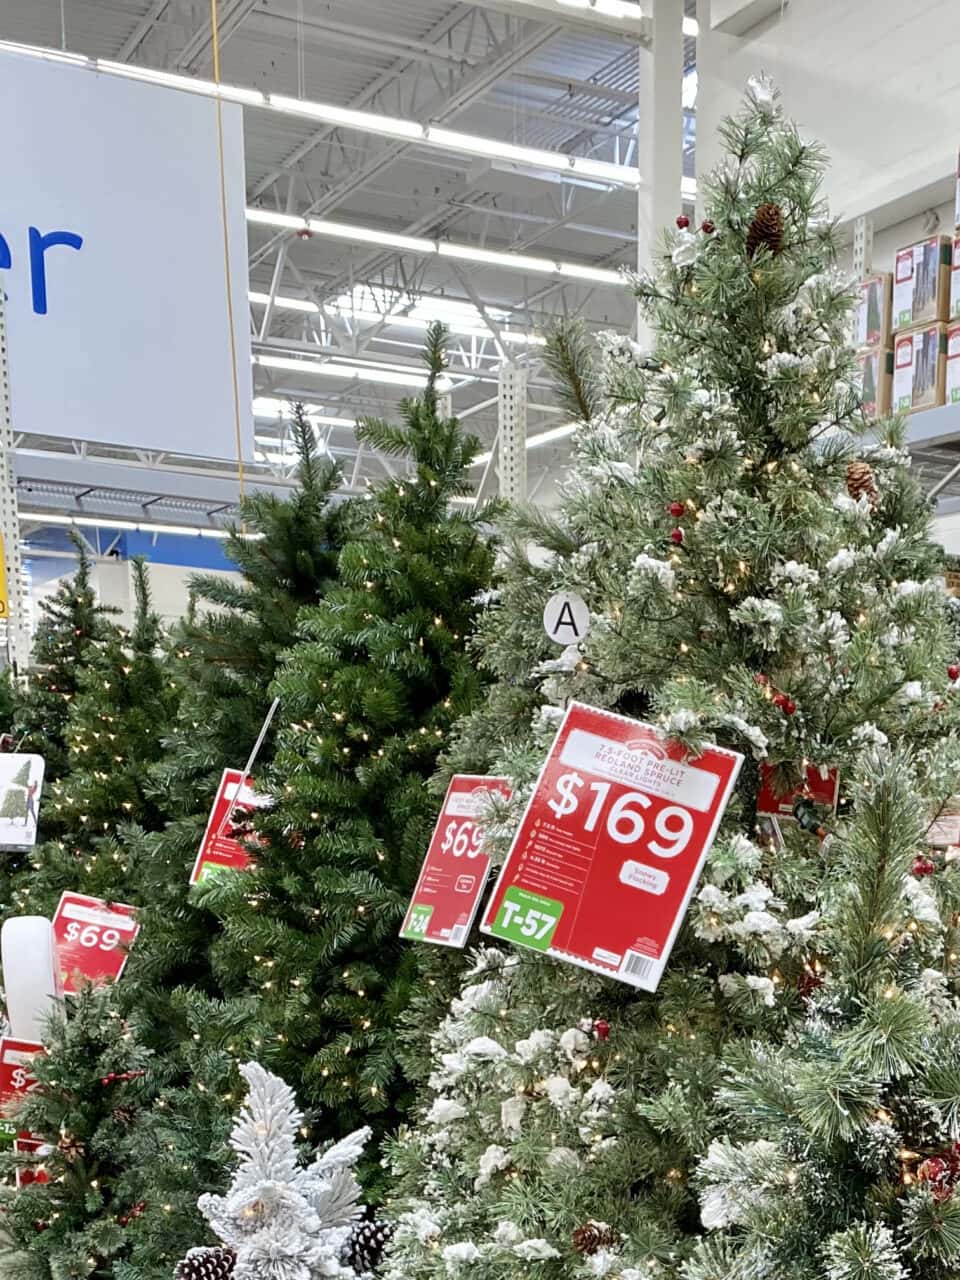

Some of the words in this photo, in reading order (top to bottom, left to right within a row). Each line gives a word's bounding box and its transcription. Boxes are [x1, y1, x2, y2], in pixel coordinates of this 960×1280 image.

[552, 601, 579, 637] A
[594, 752, 642, 773] REDLAND
[644, 766, 683, 787] SPRUCE
[646, 759, 686, 778] PRE-LIT
[548, 772, 694, 858] $169
[63, 921, 121, 952] $69
[501, 900, 557, 941] T-57
